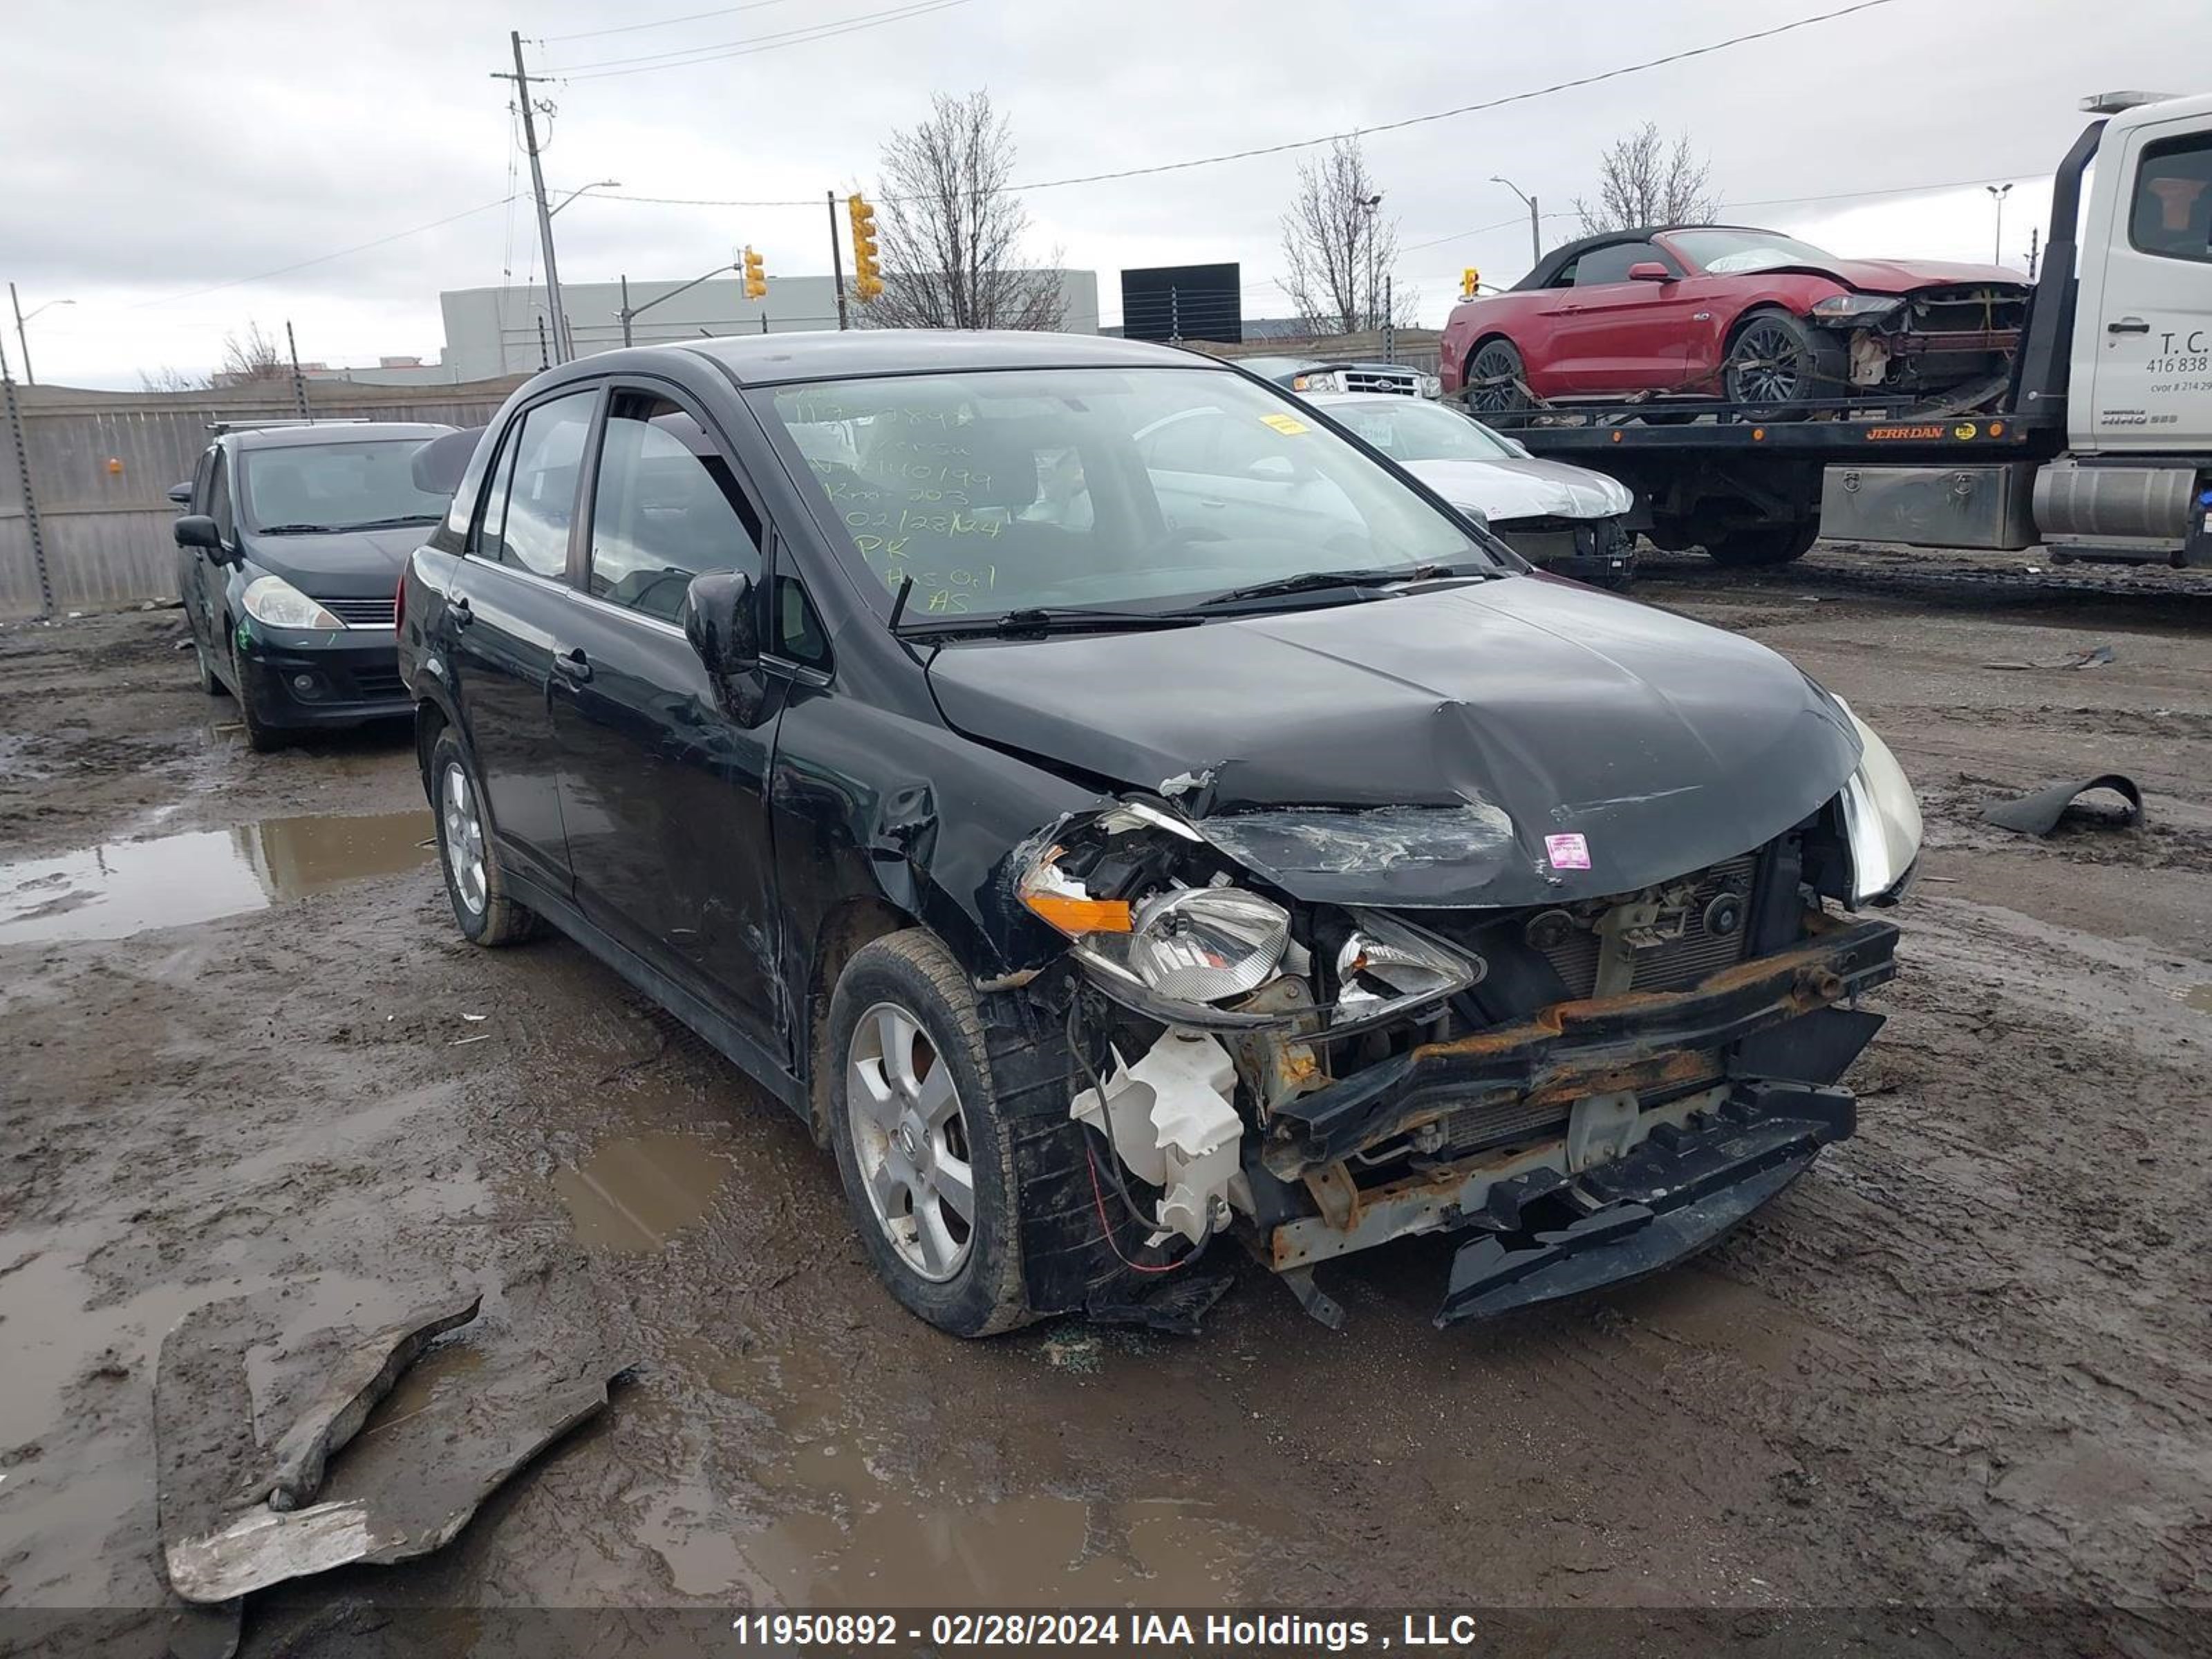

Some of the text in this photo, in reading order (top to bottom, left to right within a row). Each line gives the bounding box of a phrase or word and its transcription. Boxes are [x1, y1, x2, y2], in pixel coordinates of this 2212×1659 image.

[2161, 331, 2209, 355] T. C.
[2146, 357, 2208, 373] 416 838
[2150, 384, 2172, 393] cvor
[2182, 382, 2199, 391] 214
